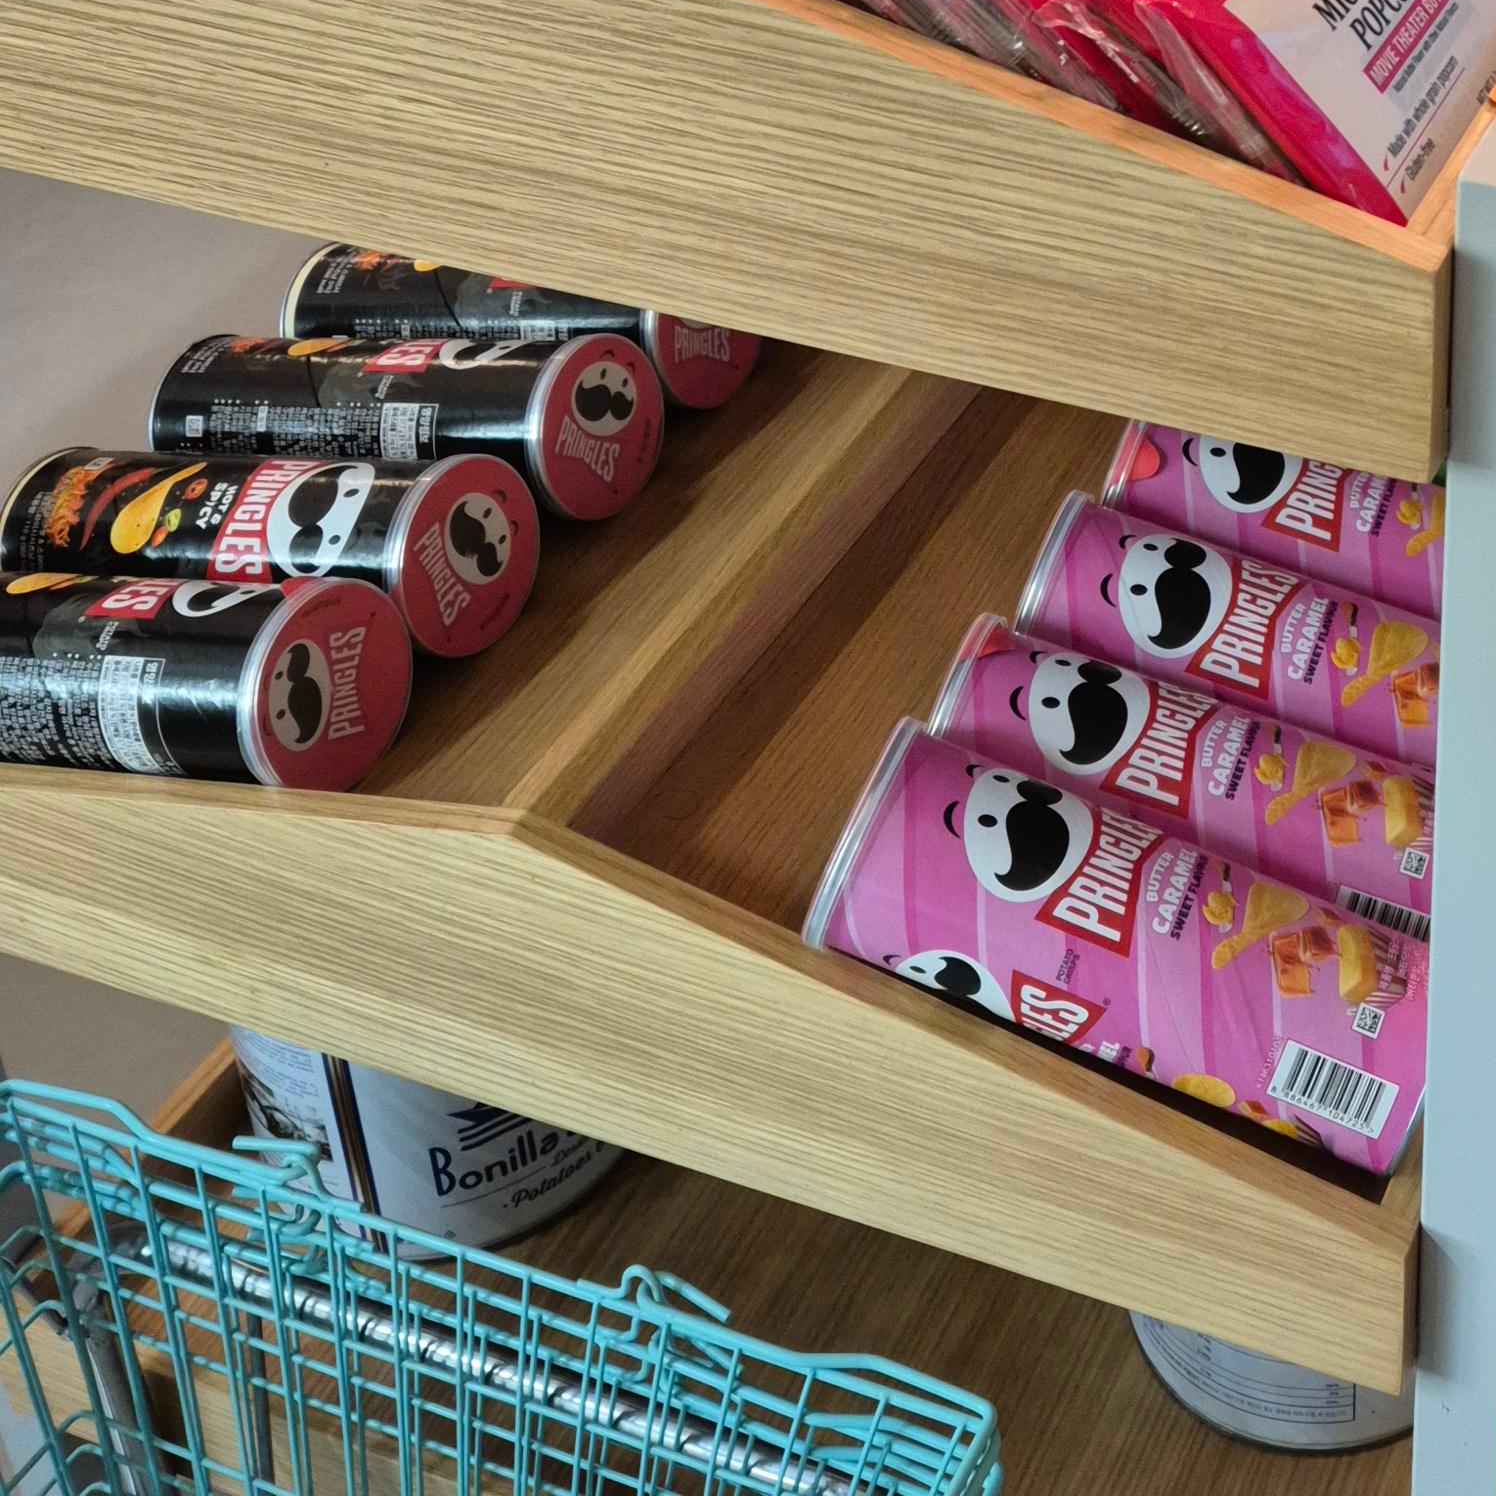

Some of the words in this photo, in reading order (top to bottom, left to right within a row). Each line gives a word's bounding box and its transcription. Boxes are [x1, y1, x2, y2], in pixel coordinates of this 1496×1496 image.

[1368, 45, 1395, 88] MOVIE
[673, 323, 731, 364] PRINGLES
[555, 413, 622, 484] PRINGLES
[195, 480, 219, 532] SPICY
[214, 459, 311, 577] PRINGLES
[223, 484, 240, 510] HOT
[1275, 459, 1345, 542] PRING
[413, 520, 471, 626] PRINGLES
[1201, 558, 1299, 689] PRINGLES
[1280, 603, 1305, 654] BUTTER
[1287, 596, 1330, 682] CARAMEL
[327, 625, 367, 743] PRINGLES
[1303, 643, 1323, 685] SWEET
[1115, 680, 1218, 807] PRINGLES
[1200, 718, 1228, 769] BUTTER
[1207, 715, 1250, 798] CARAMEL
[1225, 757, 1246, 802] SWEET
[1052, 810, 1163, 944] PRINGLES
[1145, 850, 1174, 906] BUTTER
[1151, 847, 1198, 936] CARAMEL
[1169, 894, 1192, 942] SWEET
[1056, 949, 1074, 982] POTATO
[1062, 954, 1080, 988] CRISPS
[1282, 1085, 1331, 1120] 886467
[428, 1129, 561, 1197] Bonilla
[511, 1154, 593, 1210] Potatoes
